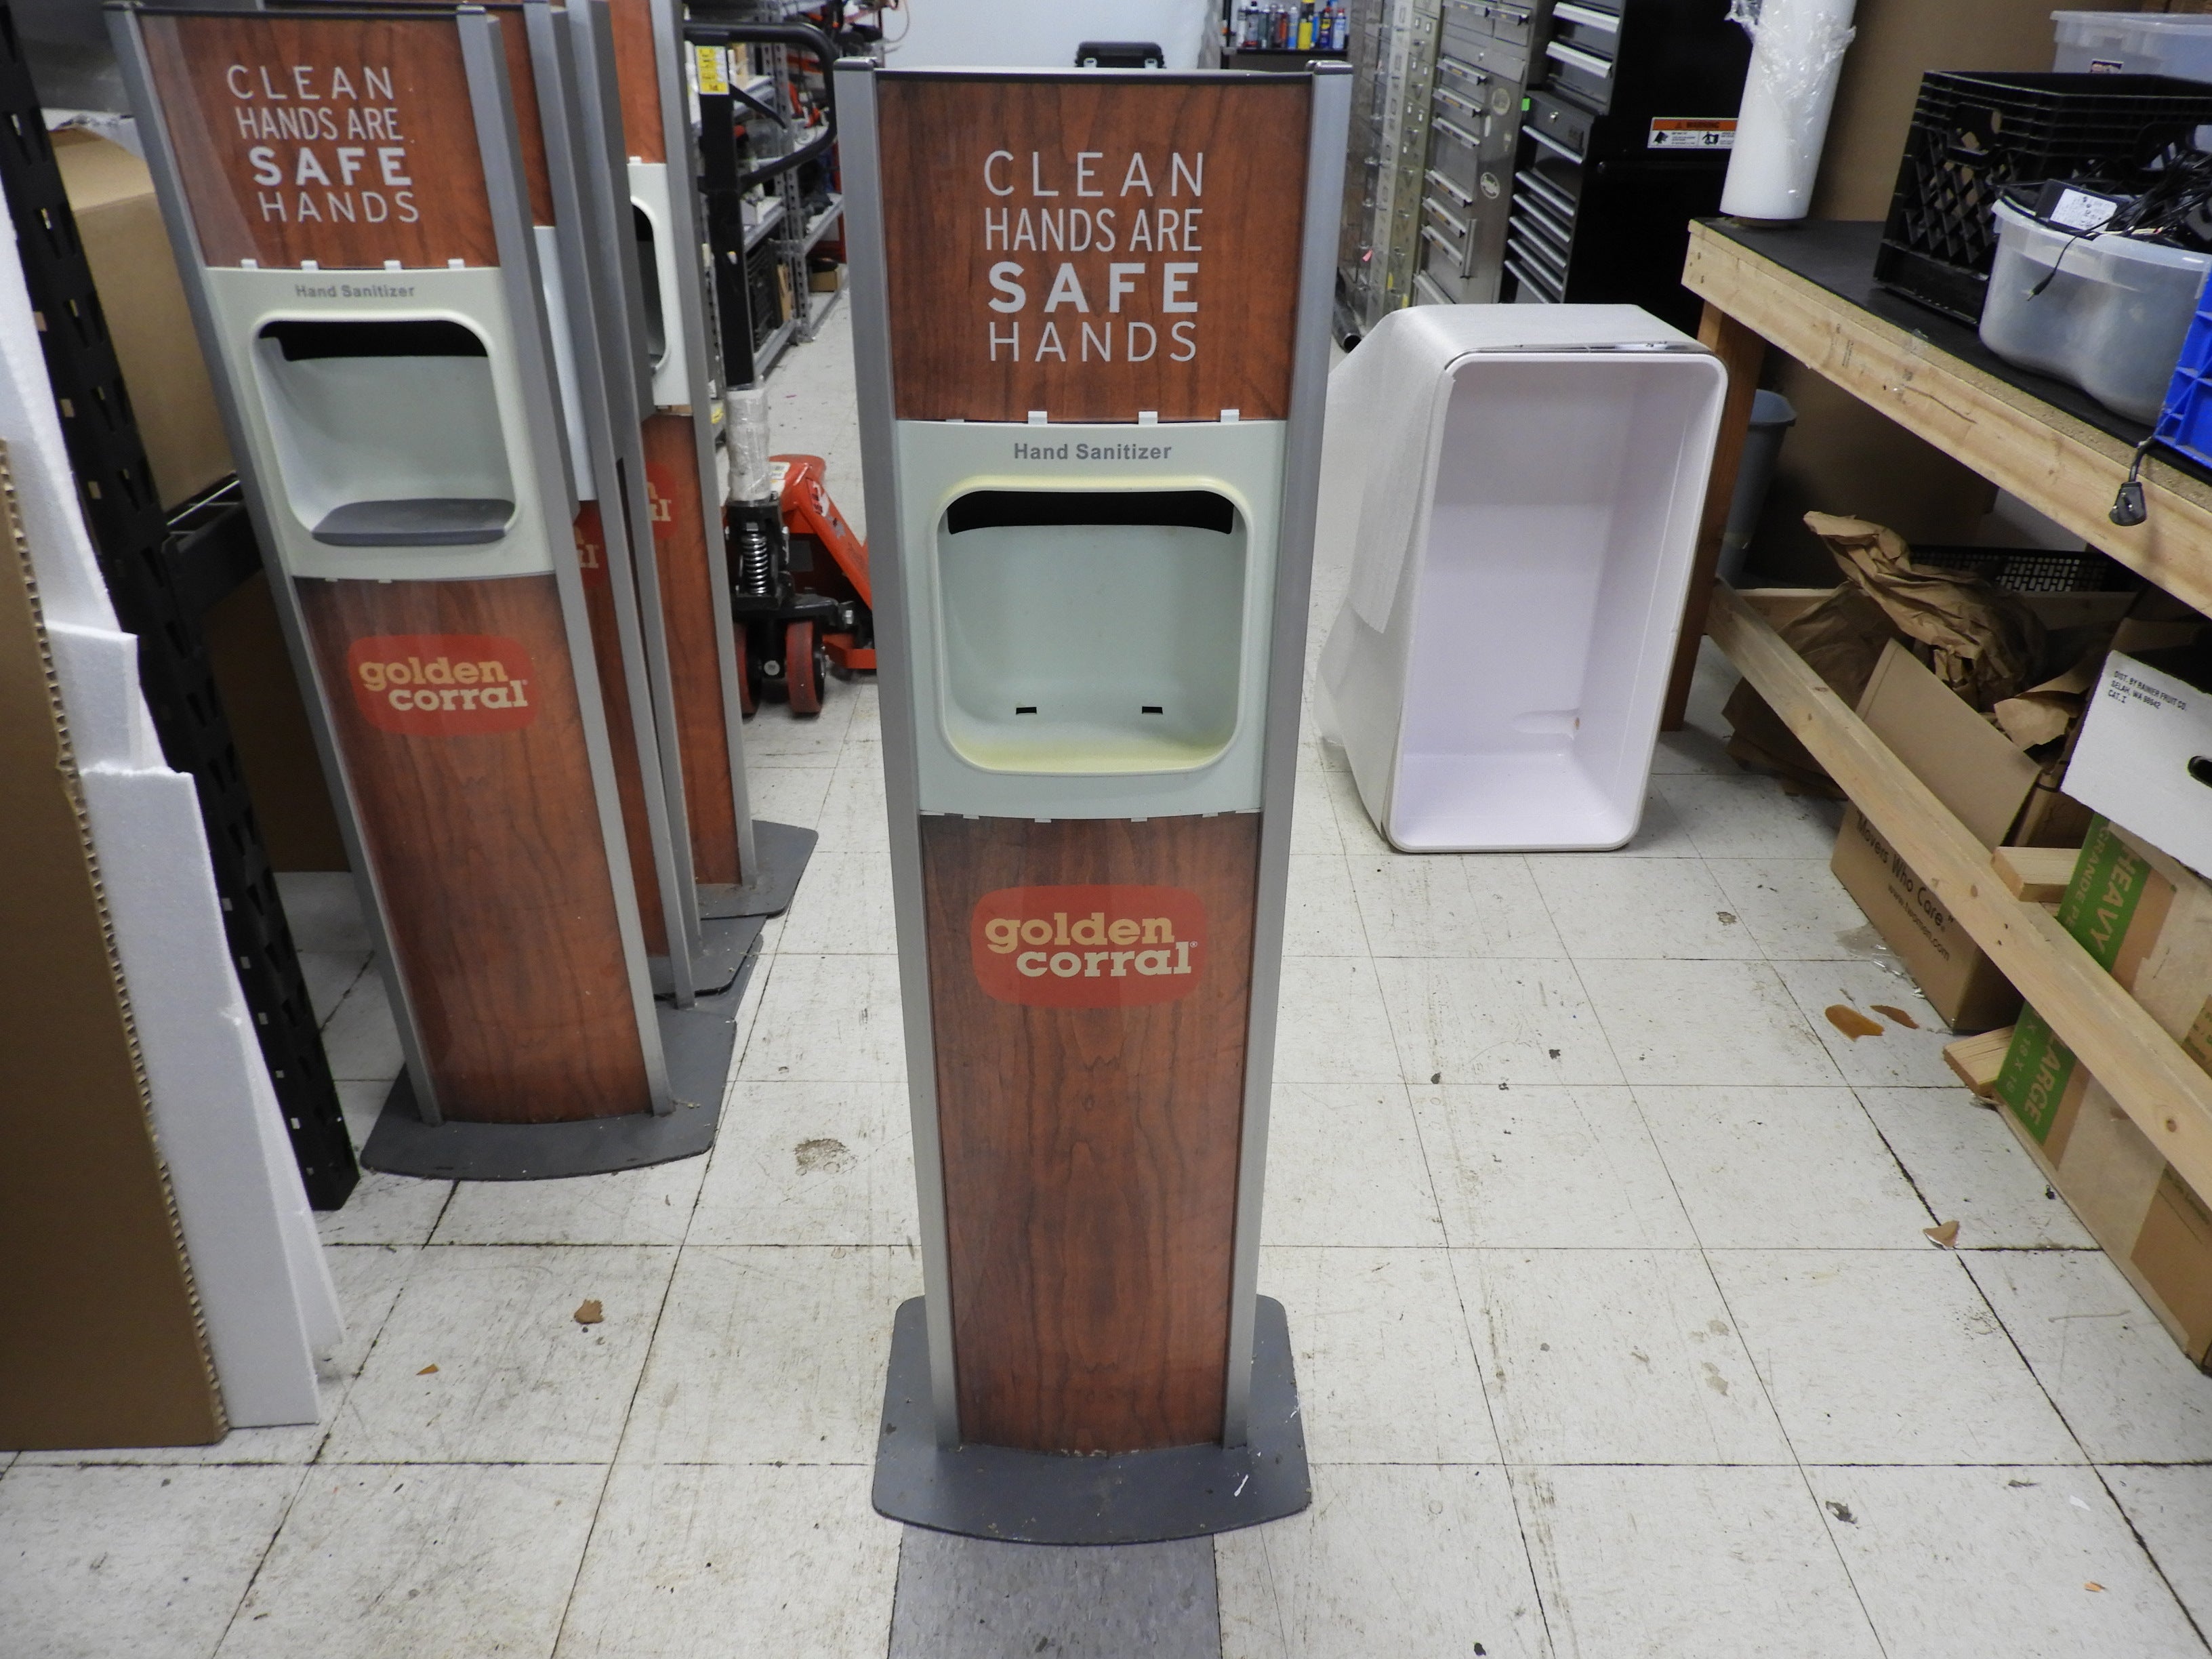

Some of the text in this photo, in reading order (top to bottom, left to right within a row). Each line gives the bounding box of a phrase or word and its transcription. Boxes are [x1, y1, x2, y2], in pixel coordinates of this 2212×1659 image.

[227, 64, 394, 100] CLEAN
[235, 107, 404, 140] HANDS ARE
[248, 146, 413, 186] SAFE
[984, 150, 1203, 197] CLEAN
[258, 190, 419, 223] HANDS
[985, 207, 1203, 252] HANDS ARE
[294, 283, 415, 298] Hand Sanitizer
[988, 261, 1199, 314] SAFE
[989, 321, 1196, 362] HANDS
[1014, 443, 1172, 460] Hand Sanitizer
[359, 656, 508, 692] golden
[1891, 853, 1914, 893] Who
[2091, 847, 2141, 954] HEAVY
[985, 912, 1175, 954] golden
